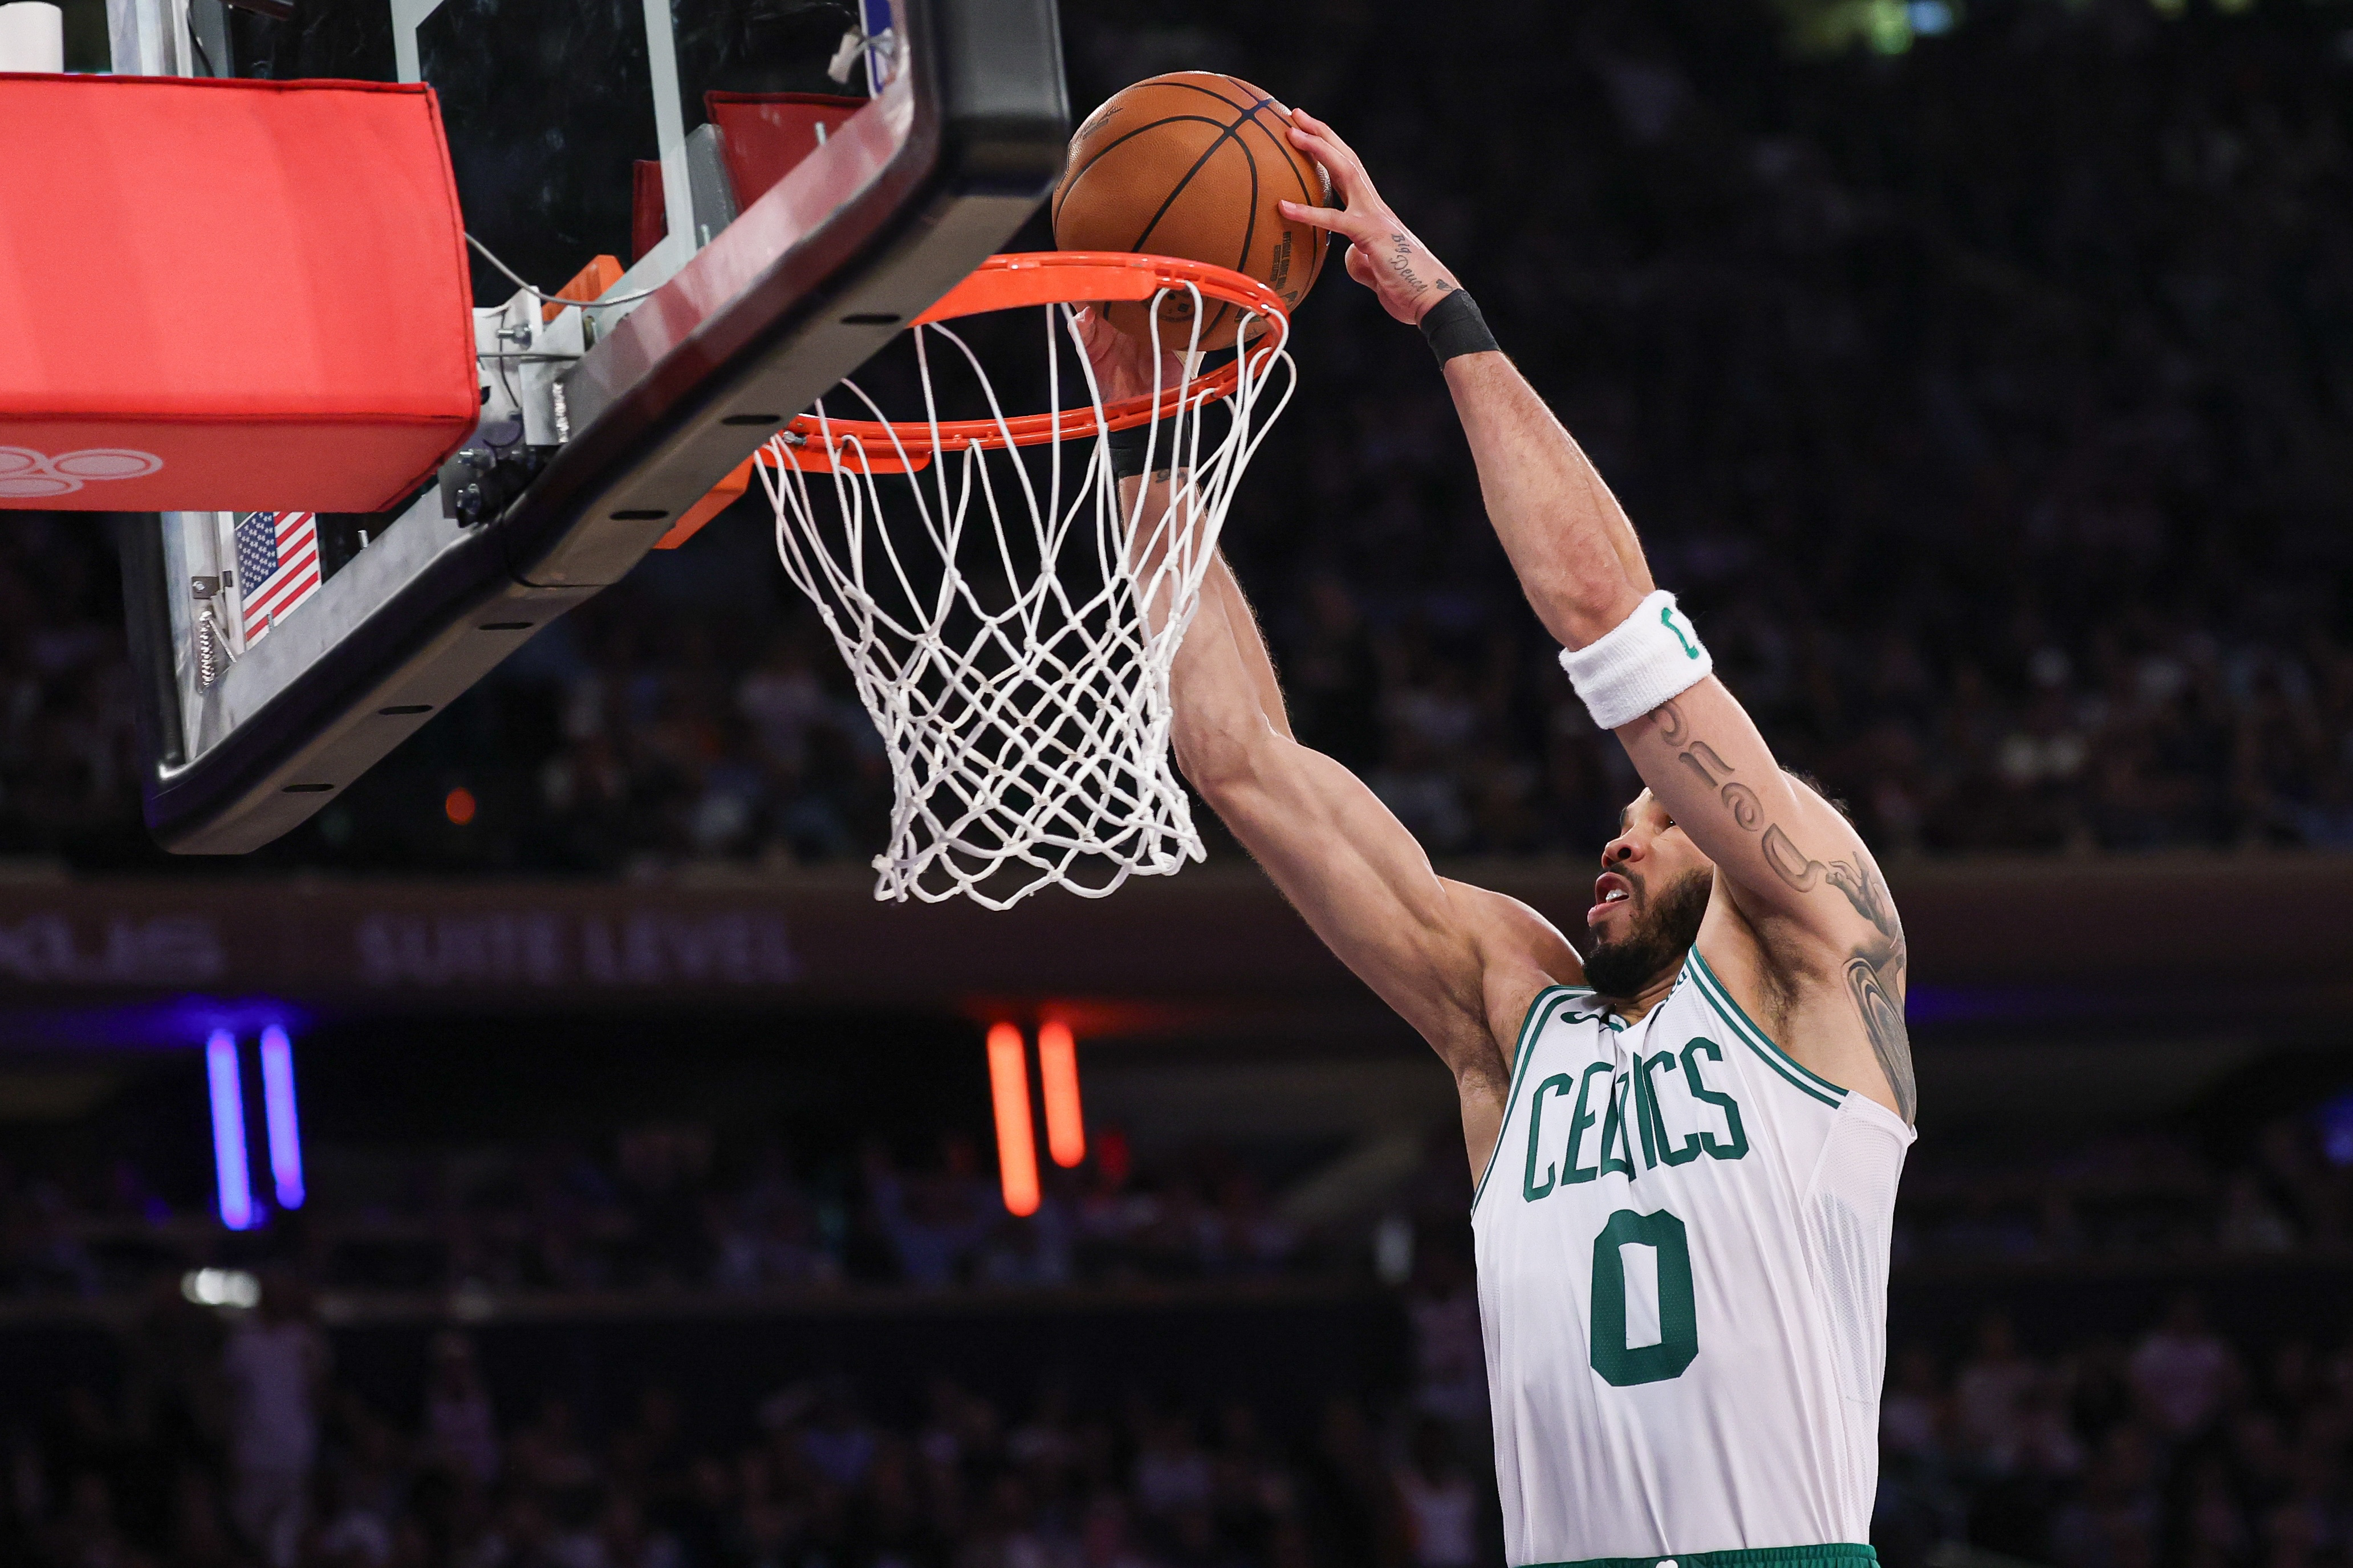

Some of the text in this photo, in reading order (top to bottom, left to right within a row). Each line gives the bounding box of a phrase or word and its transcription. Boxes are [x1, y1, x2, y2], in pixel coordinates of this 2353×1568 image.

[1388, 234, 1428, 292] Big Deuce
[356, 911, 564, 985] SUITE
[584, 911, 799, 984] LEVEL
[1590, 1209, 1699, 1387] 0
